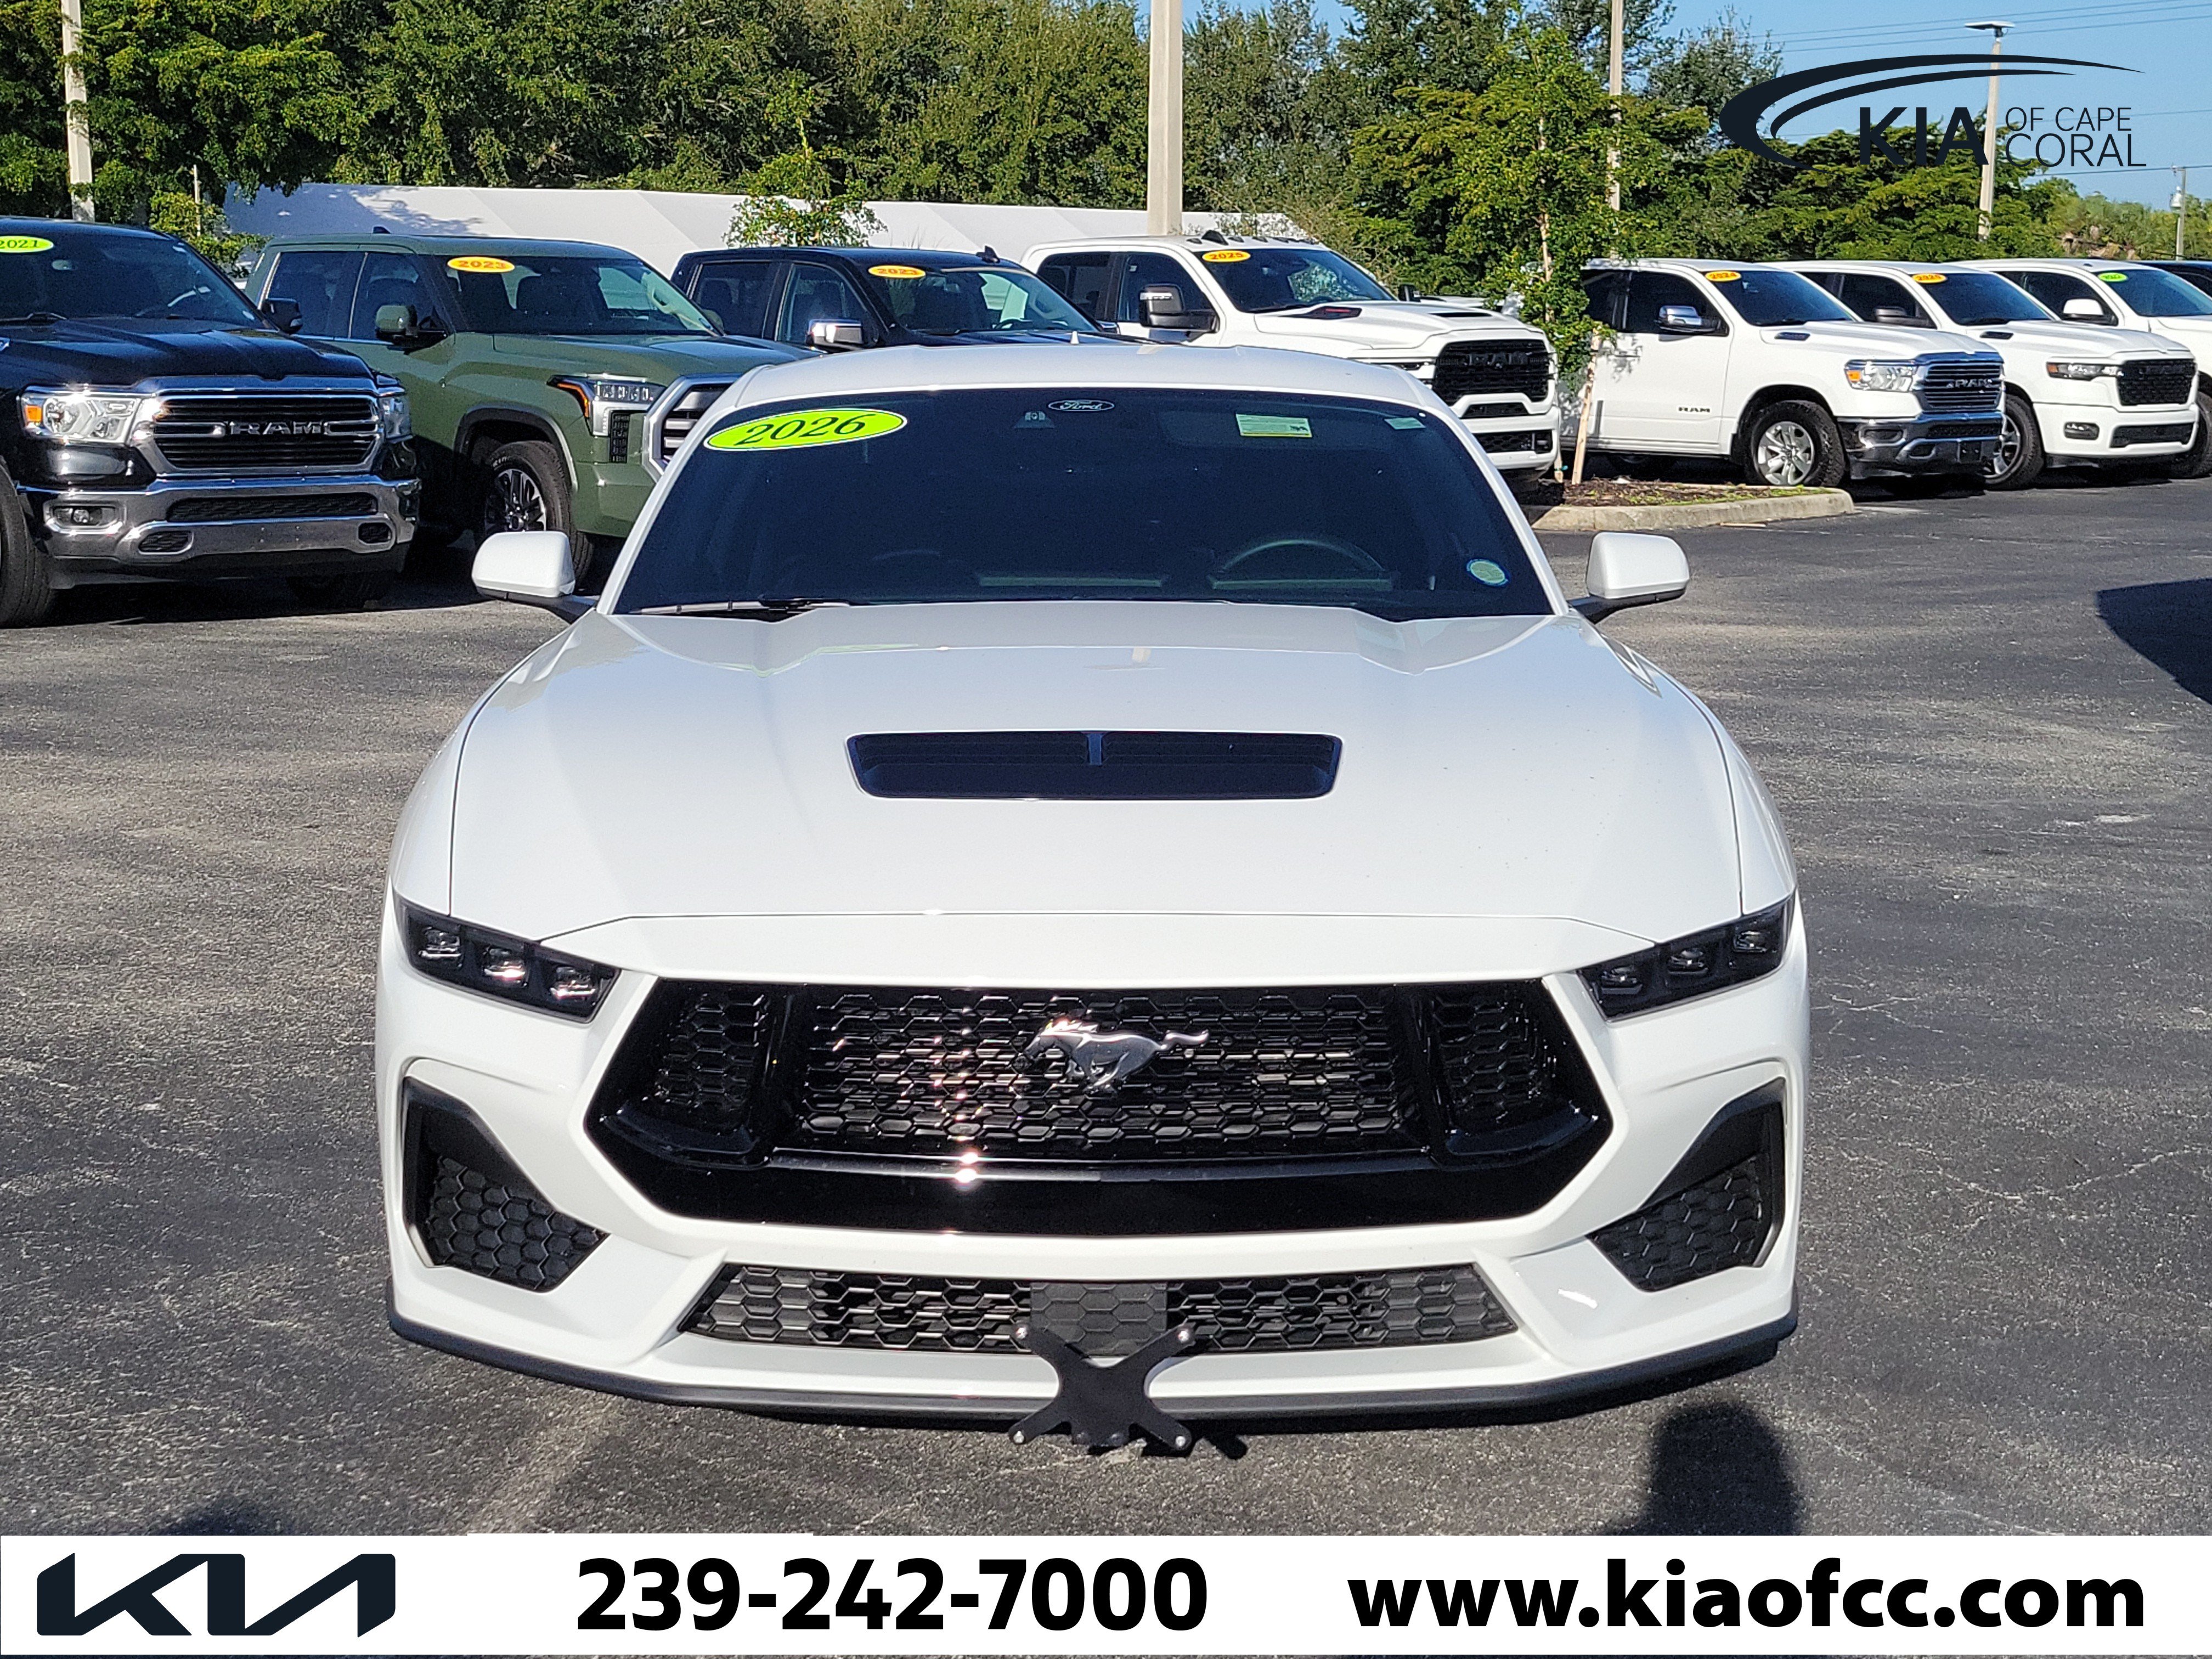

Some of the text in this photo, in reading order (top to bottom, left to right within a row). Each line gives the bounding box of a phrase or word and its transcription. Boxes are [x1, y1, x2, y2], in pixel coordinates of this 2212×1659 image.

[1059, 399, 1103, 410] Ford
[230, 421, 321, 436] RAM
[733, 414, 876, 446] 2026
